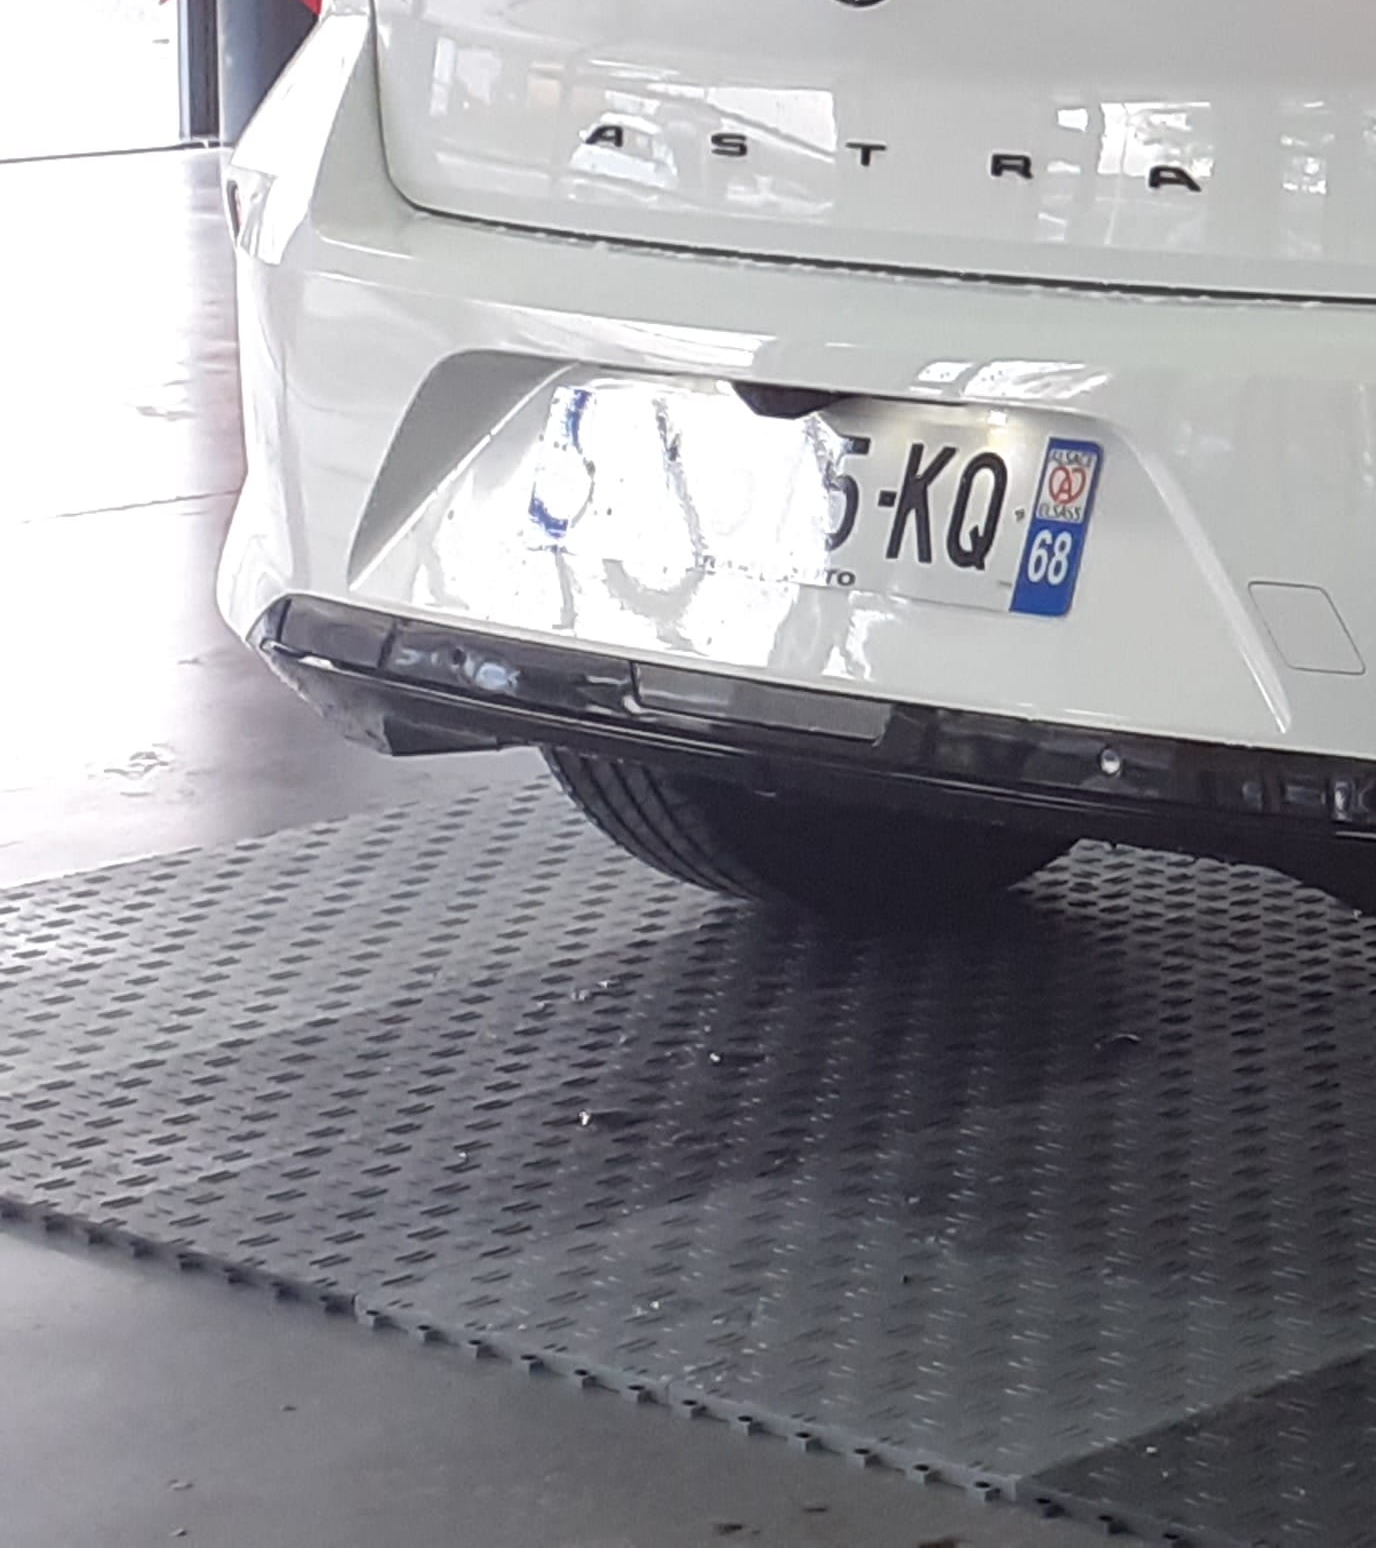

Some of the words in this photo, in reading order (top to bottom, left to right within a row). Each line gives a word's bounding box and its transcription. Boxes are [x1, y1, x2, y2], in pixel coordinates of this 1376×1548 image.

[586, 125, 1202, 191] ASTRA
[826, 435, 1008, 570] 5-KQ
[1027, 528, 1073, 586] 68
